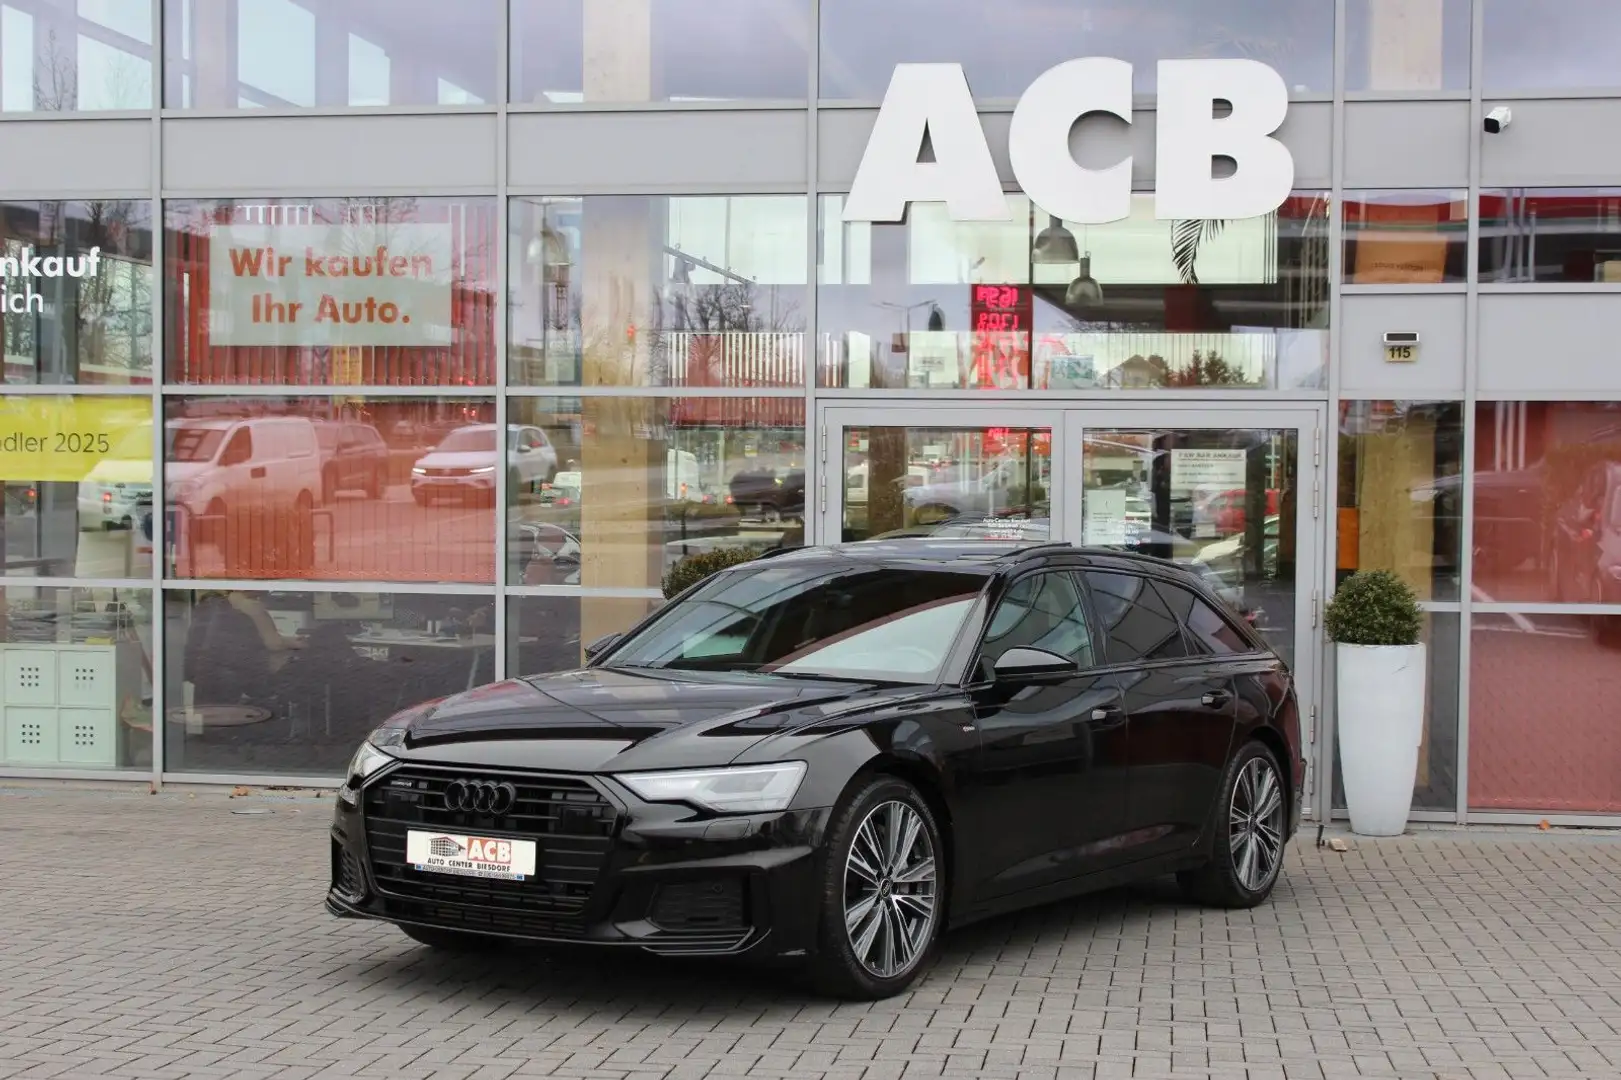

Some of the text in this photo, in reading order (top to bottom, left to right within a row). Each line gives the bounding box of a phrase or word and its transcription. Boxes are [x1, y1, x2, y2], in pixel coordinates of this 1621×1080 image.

[843, 57, 1295, 224] ACB
[0, 246, 100, 277] nkauf
[229, 243, 432, 277] Wir kaufen
[1, 283, 44, 313] ich
[252, 293, 410, 323] Ihr Auto.
[1389, 346, 1411, 359] 115
[0, 432, 110, 453] dler 2025
[427, 858, 511, 872] AUTO CENTER BIESDORF
[469, 839, 511, 863] ACB
